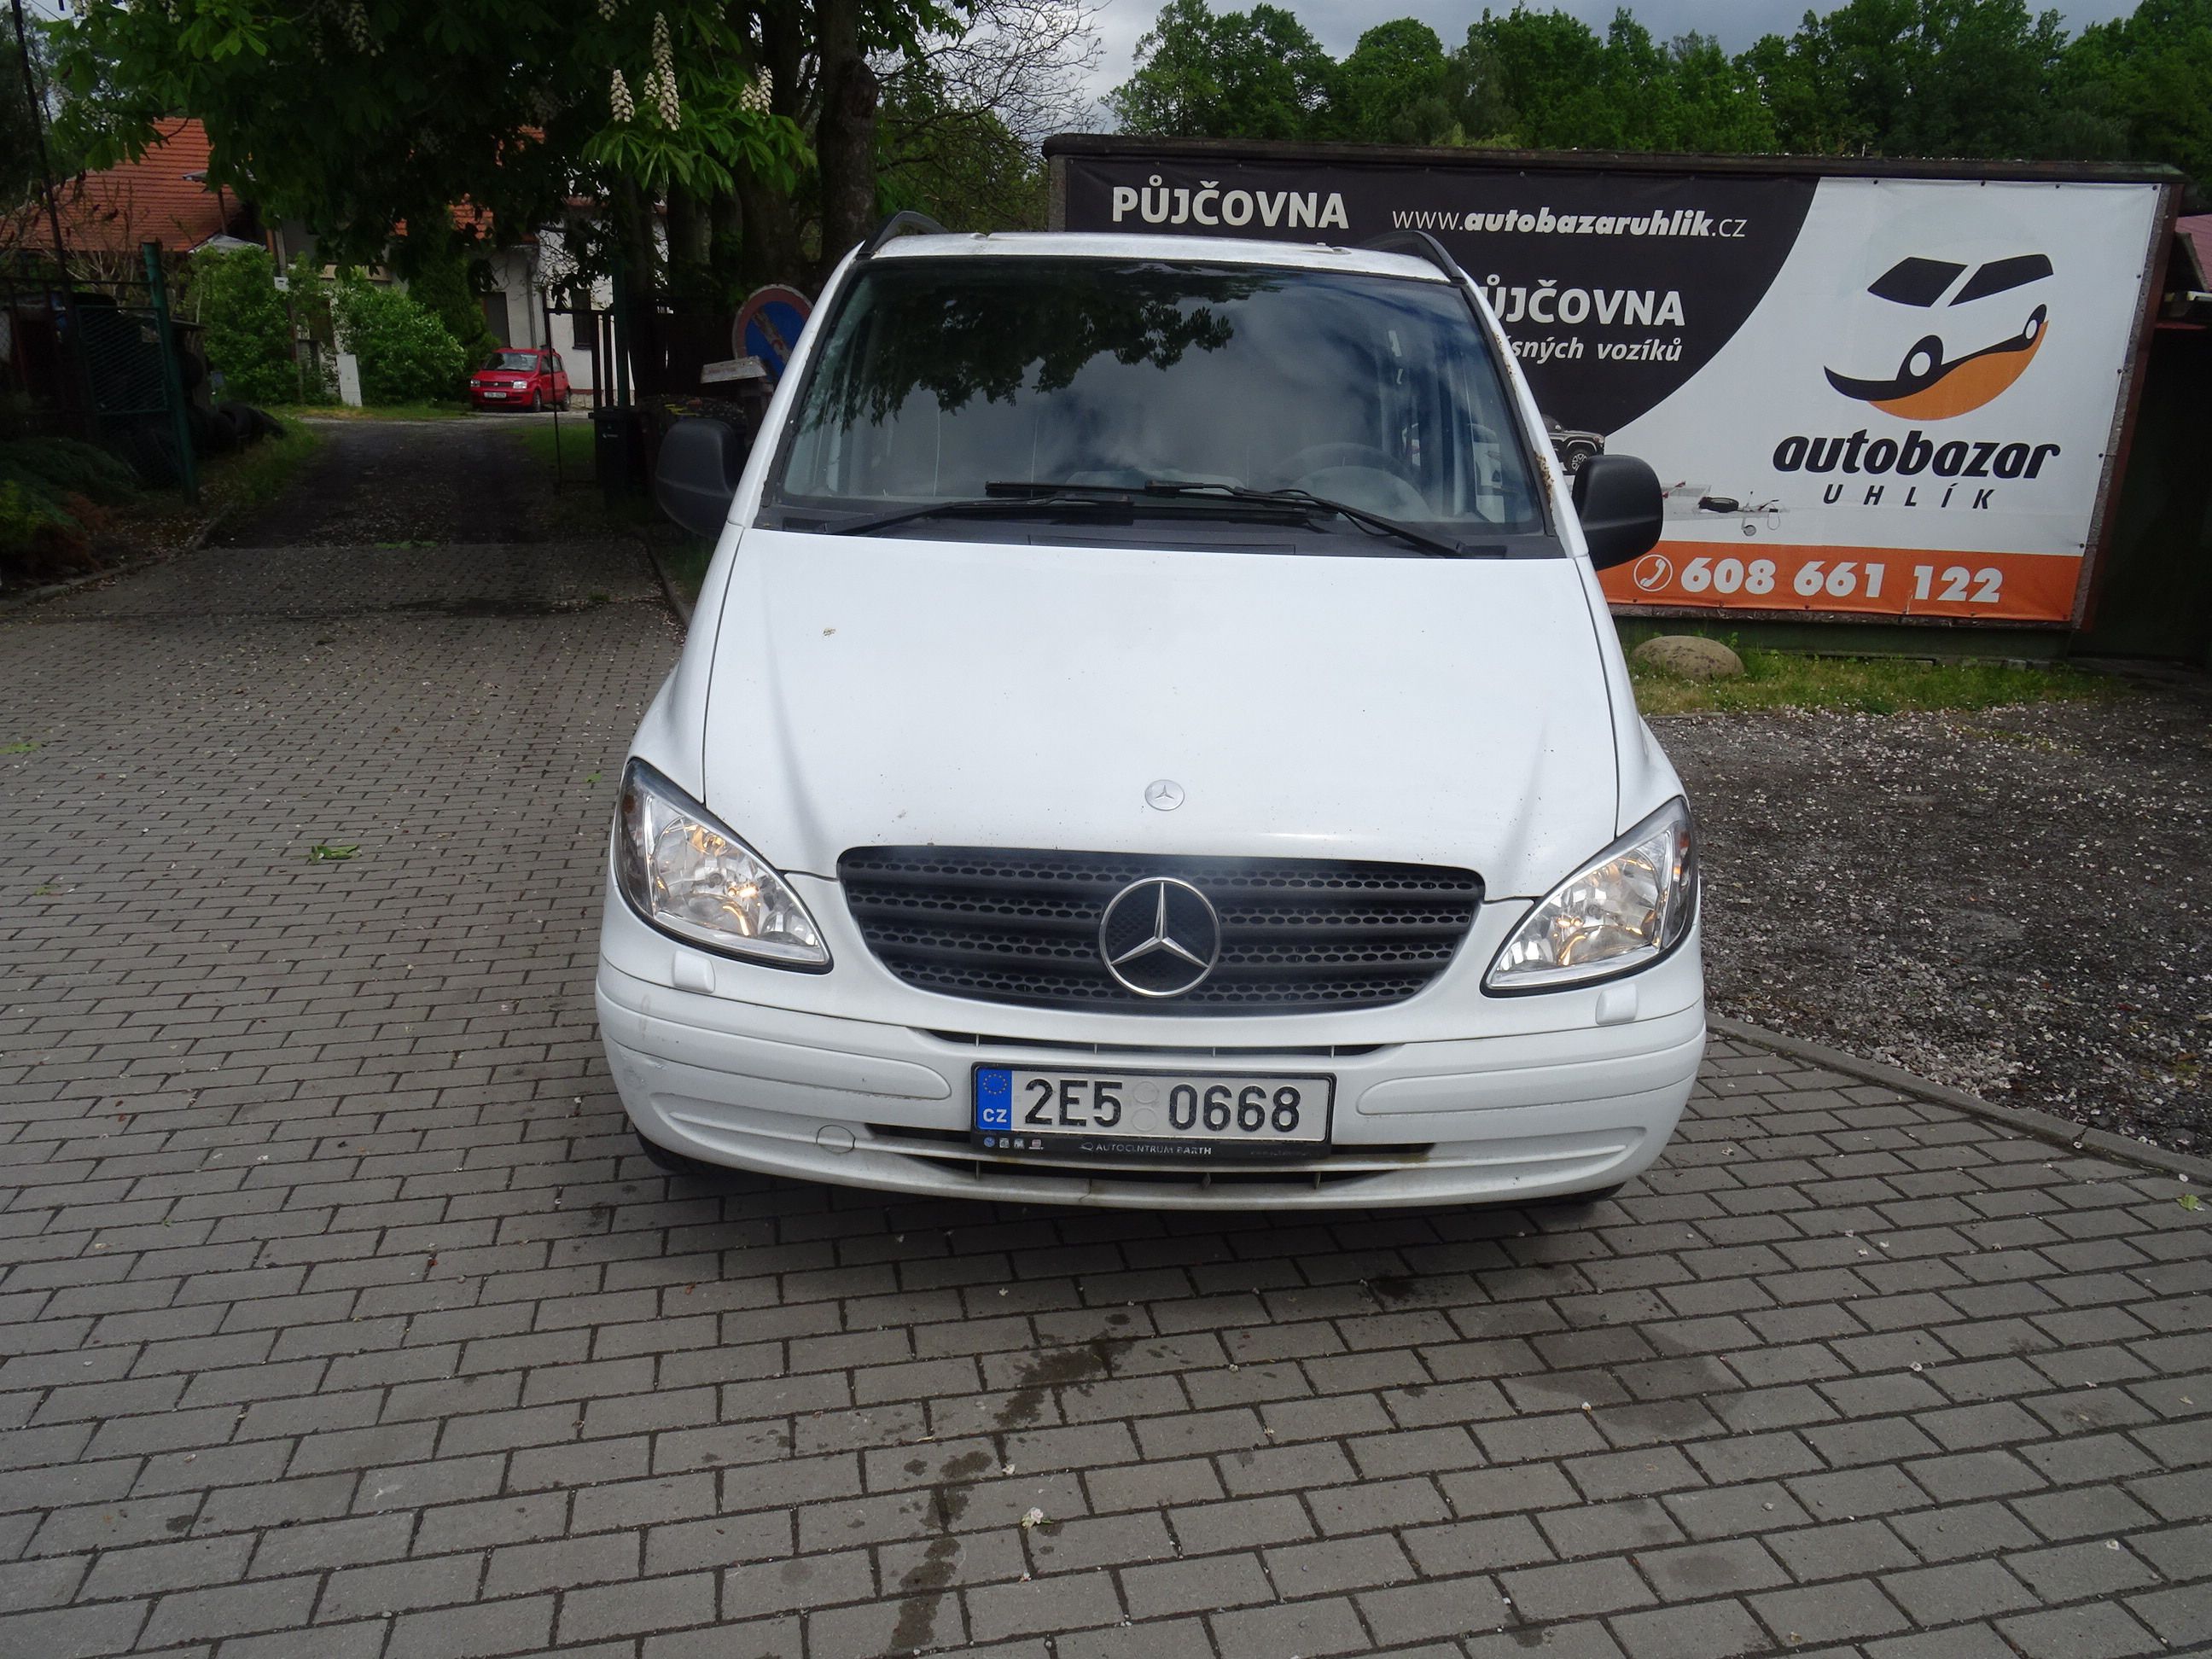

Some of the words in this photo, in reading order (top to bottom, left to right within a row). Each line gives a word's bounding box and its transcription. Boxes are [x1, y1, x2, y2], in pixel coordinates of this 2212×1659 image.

[1113, 174, 1349, 230] PŮJČOVNA
[1392, 207, 1748, 237] www.autobazaruhlik.cz
[1479, 274, 1685, 326] ŮJČOVNA
[1508, 336, 1584, 364] sných
[1598, 337, 1682, 362] vozíků
[1773, 428, 2061, 479] autobazar
[1823, 482, 1995, 509] UHLÍK
[1680, 557, 1776, 595] 608
[1793, 561, 1885, 597] 661
[1913, 565, 2003, 603] 122
[982, 1108, 1007, 1123] CZ
[1025, 1079, 1123, 1127] 2E5
[1169, 1084, 1301, 1132] 0668
[1096, 1144, 1173, 1154] AUTOCNTRUM
